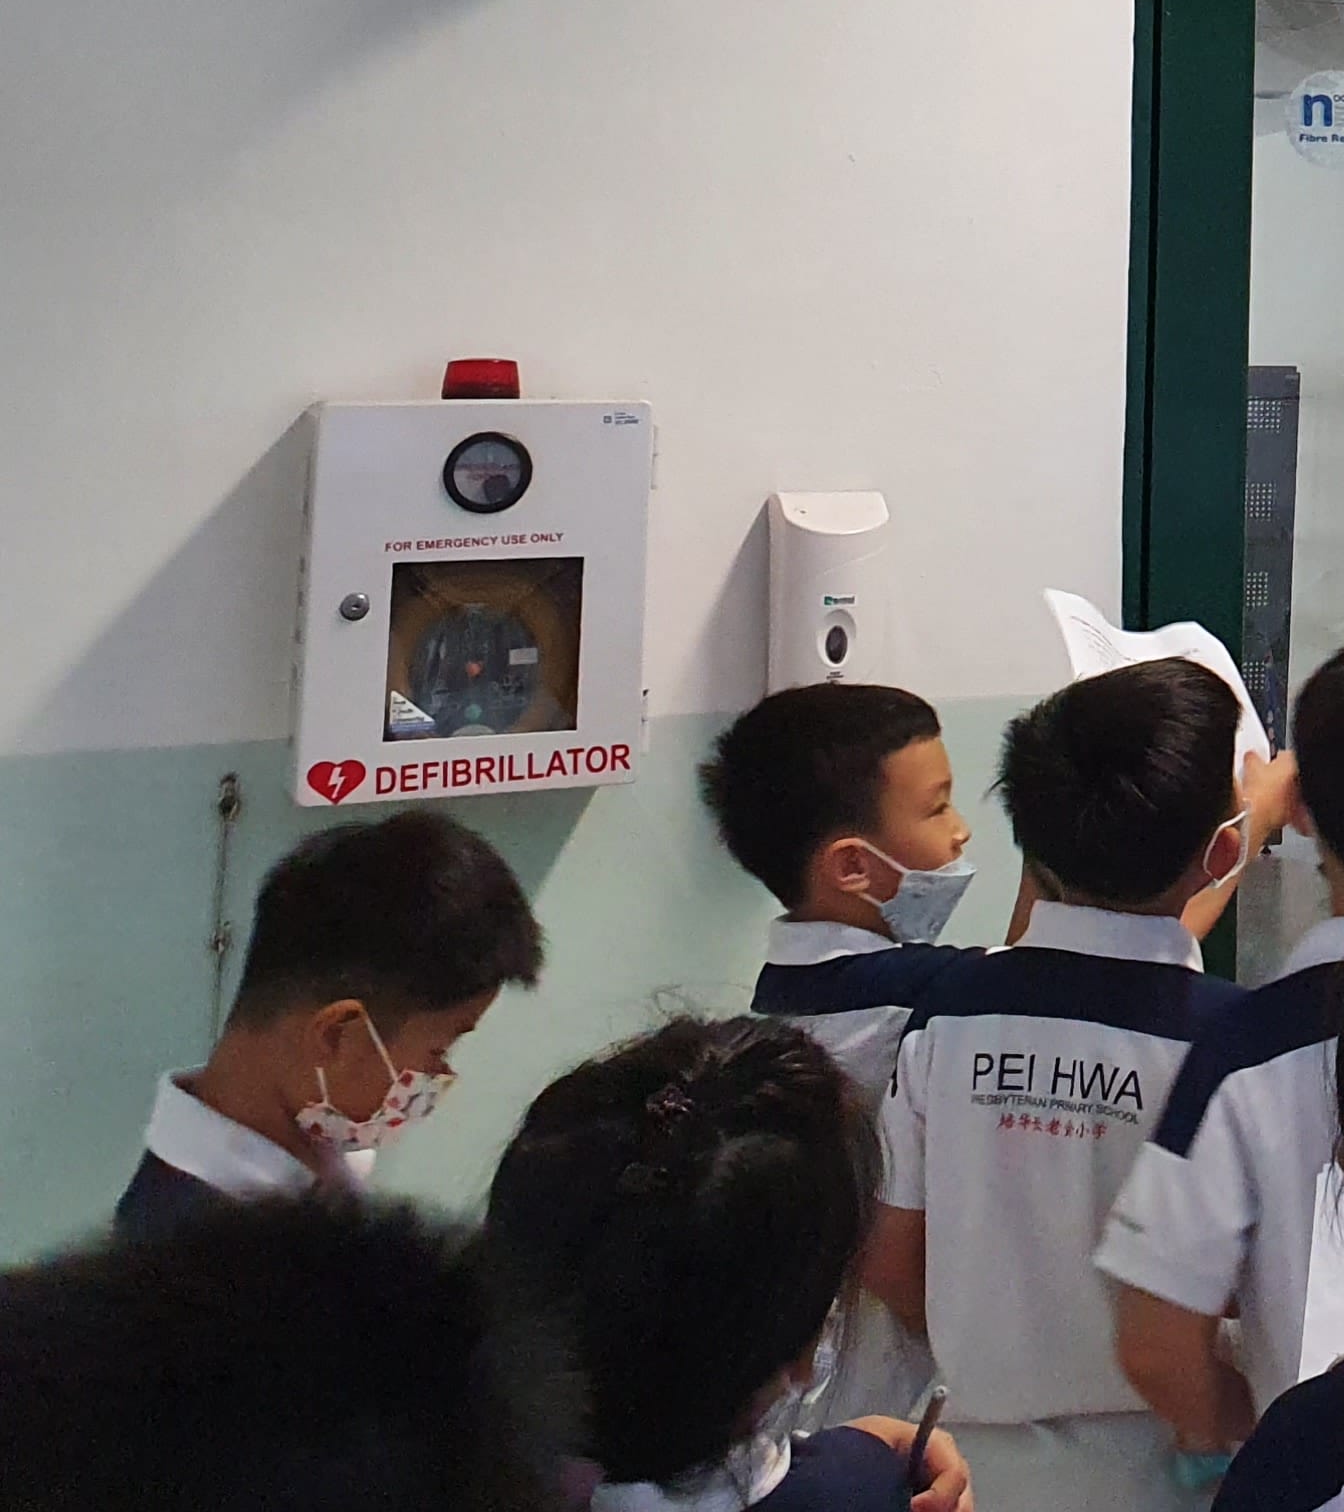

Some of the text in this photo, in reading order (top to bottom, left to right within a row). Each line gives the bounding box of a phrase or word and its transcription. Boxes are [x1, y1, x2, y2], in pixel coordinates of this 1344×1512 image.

[1299, 133, 1328, 143] Fibre
[384, 532, 564, 552] FOR EMERGENCY USE ONLY
[375, 743, 632, 795] DEFIBRILLATOR
[972, 1052, 1144, 1111] PEI HWA
